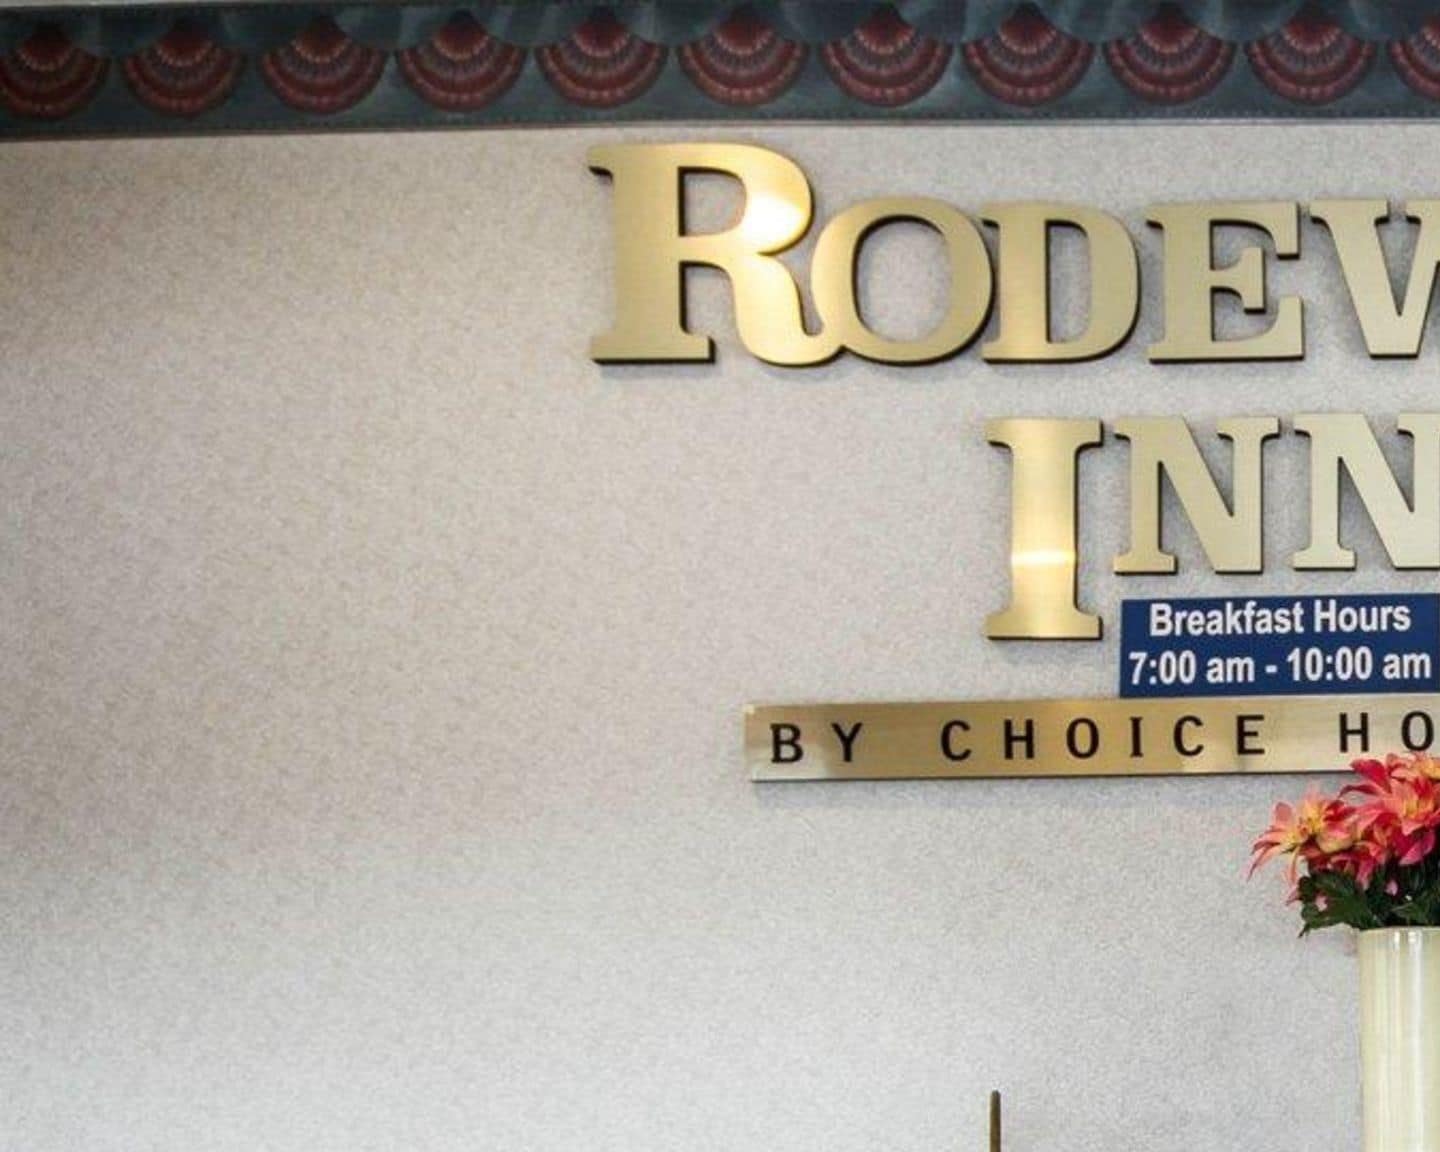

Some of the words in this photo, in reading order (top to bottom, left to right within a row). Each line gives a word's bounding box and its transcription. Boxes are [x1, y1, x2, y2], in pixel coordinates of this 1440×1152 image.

[1150, 601, 1304, 636] Breakfast
[1314, 599, 1411, 633] Hours
[1128, 651, 1197, 685] 7:00
[1206, 656, 1255, 683] am
[1287, 647, 1373, 682] 10:00
[1382, 652, 1431, 679] am
[770, 722, 863, 764] BY
[940, 714, 1266, 761] CHOICE
